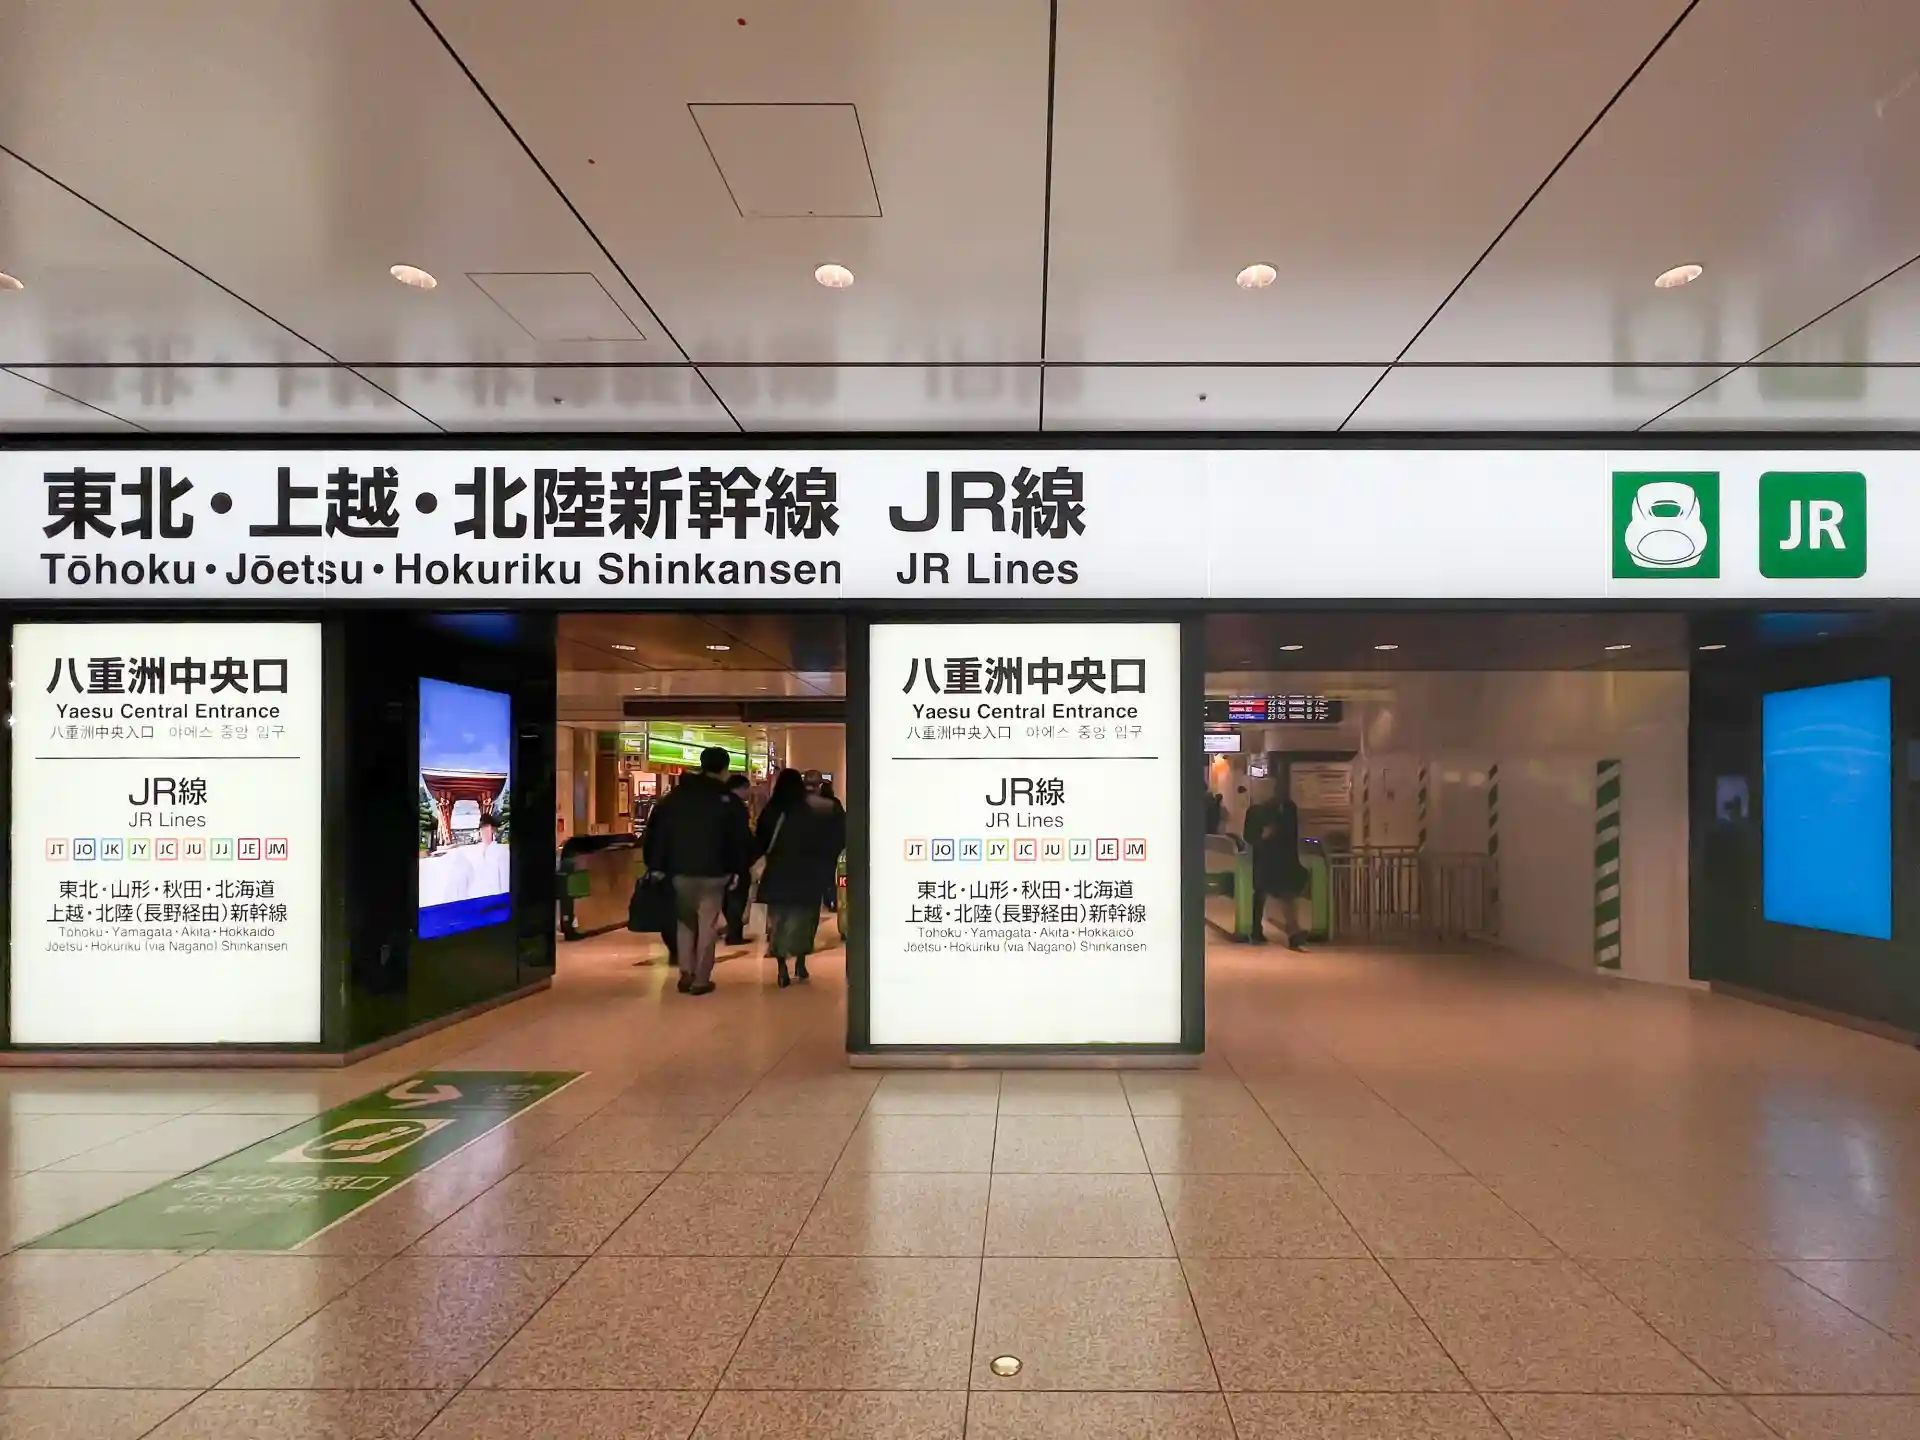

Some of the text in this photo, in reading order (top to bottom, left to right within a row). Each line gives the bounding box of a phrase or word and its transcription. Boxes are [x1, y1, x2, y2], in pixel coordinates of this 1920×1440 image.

[889, 467, 1086, 538] JR線
[1780, 501, 1845, 549] JR
[599, 553, 840, 584] Shinkansen
[897, 553, 949, 584] JR
[968, 553, 1078, 584] Lines
[46, 657, 287, 694] 八重洲中央口
[902, 657, 1145, 695] 八重洲中央口
[57, 704, 279, 718] Yaesu Central Entrance
[913, 704, 1137, 719] Yaesu Central Entrance
[50, 725, 153, 739] 八重洲中央入口
[907, 725, 1010, 740] 八重洲中央入口
[129, 777, 207, 805] JR線
[986, 777, 1064, 806] JR線
[129, 812, 206, 827] JR Lines
[986, 813, 1063, 827] JR Lines
[51, 844, 284, 854] JT JO JK JY JC JU JJ JE JM
[909, 844, 1143, 855] JT JO JK JY JC JU JJ JE JM
